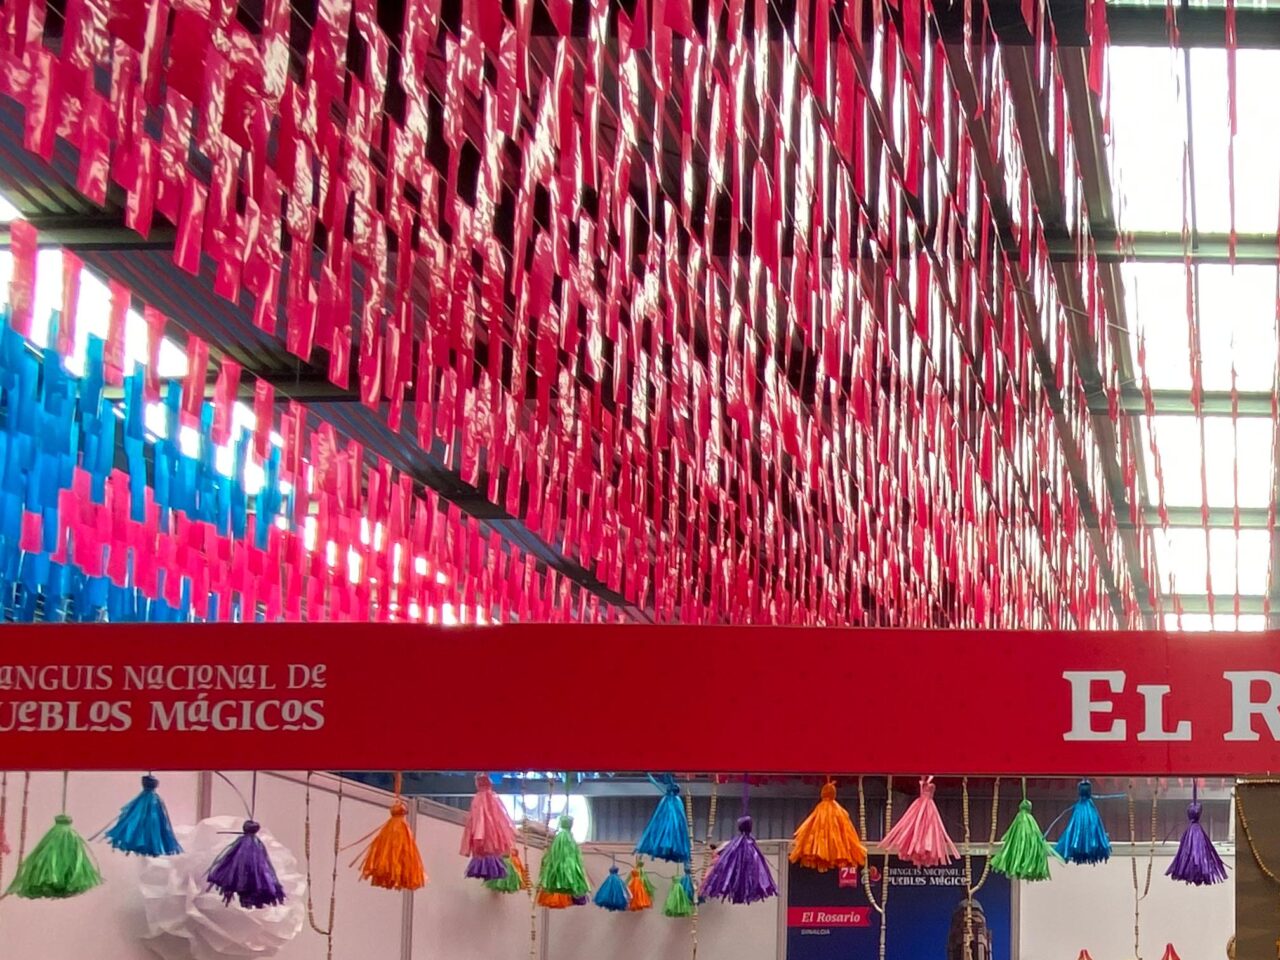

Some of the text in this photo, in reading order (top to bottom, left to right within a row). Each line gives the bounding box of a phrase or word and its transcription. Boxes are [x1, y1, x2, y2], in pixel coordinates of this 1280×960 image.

[1062, 670, 1193, 742] EL
[801, 911, 861, 923] El Rosario
